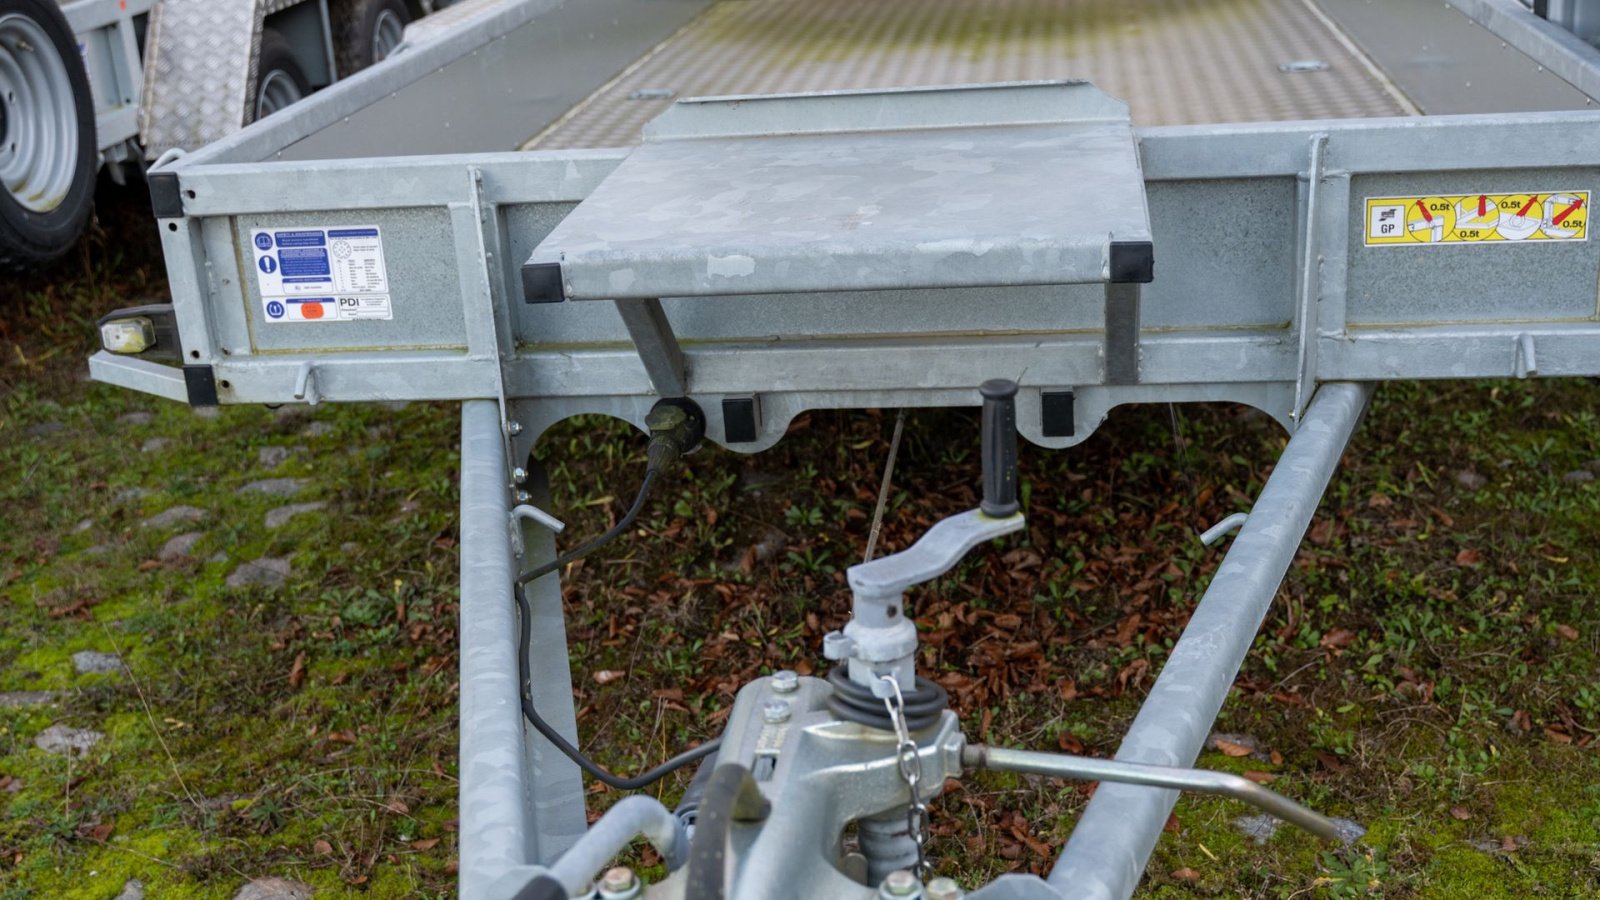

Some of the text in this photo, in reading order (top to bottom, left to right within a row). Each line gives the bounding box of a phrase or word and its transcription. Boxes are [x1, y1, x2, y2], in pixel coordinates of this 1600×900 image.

[1430, 203, 1450, 211] 0.5t
[1501, 201, 1520, 209] 0.5t
[1562, 220, 1582, 228] 0.5t
[1381, 224, 1395, 234] GP
[1459, 230, 1479, 238] 0.5t
[340, 298, 359, 306] PDI
